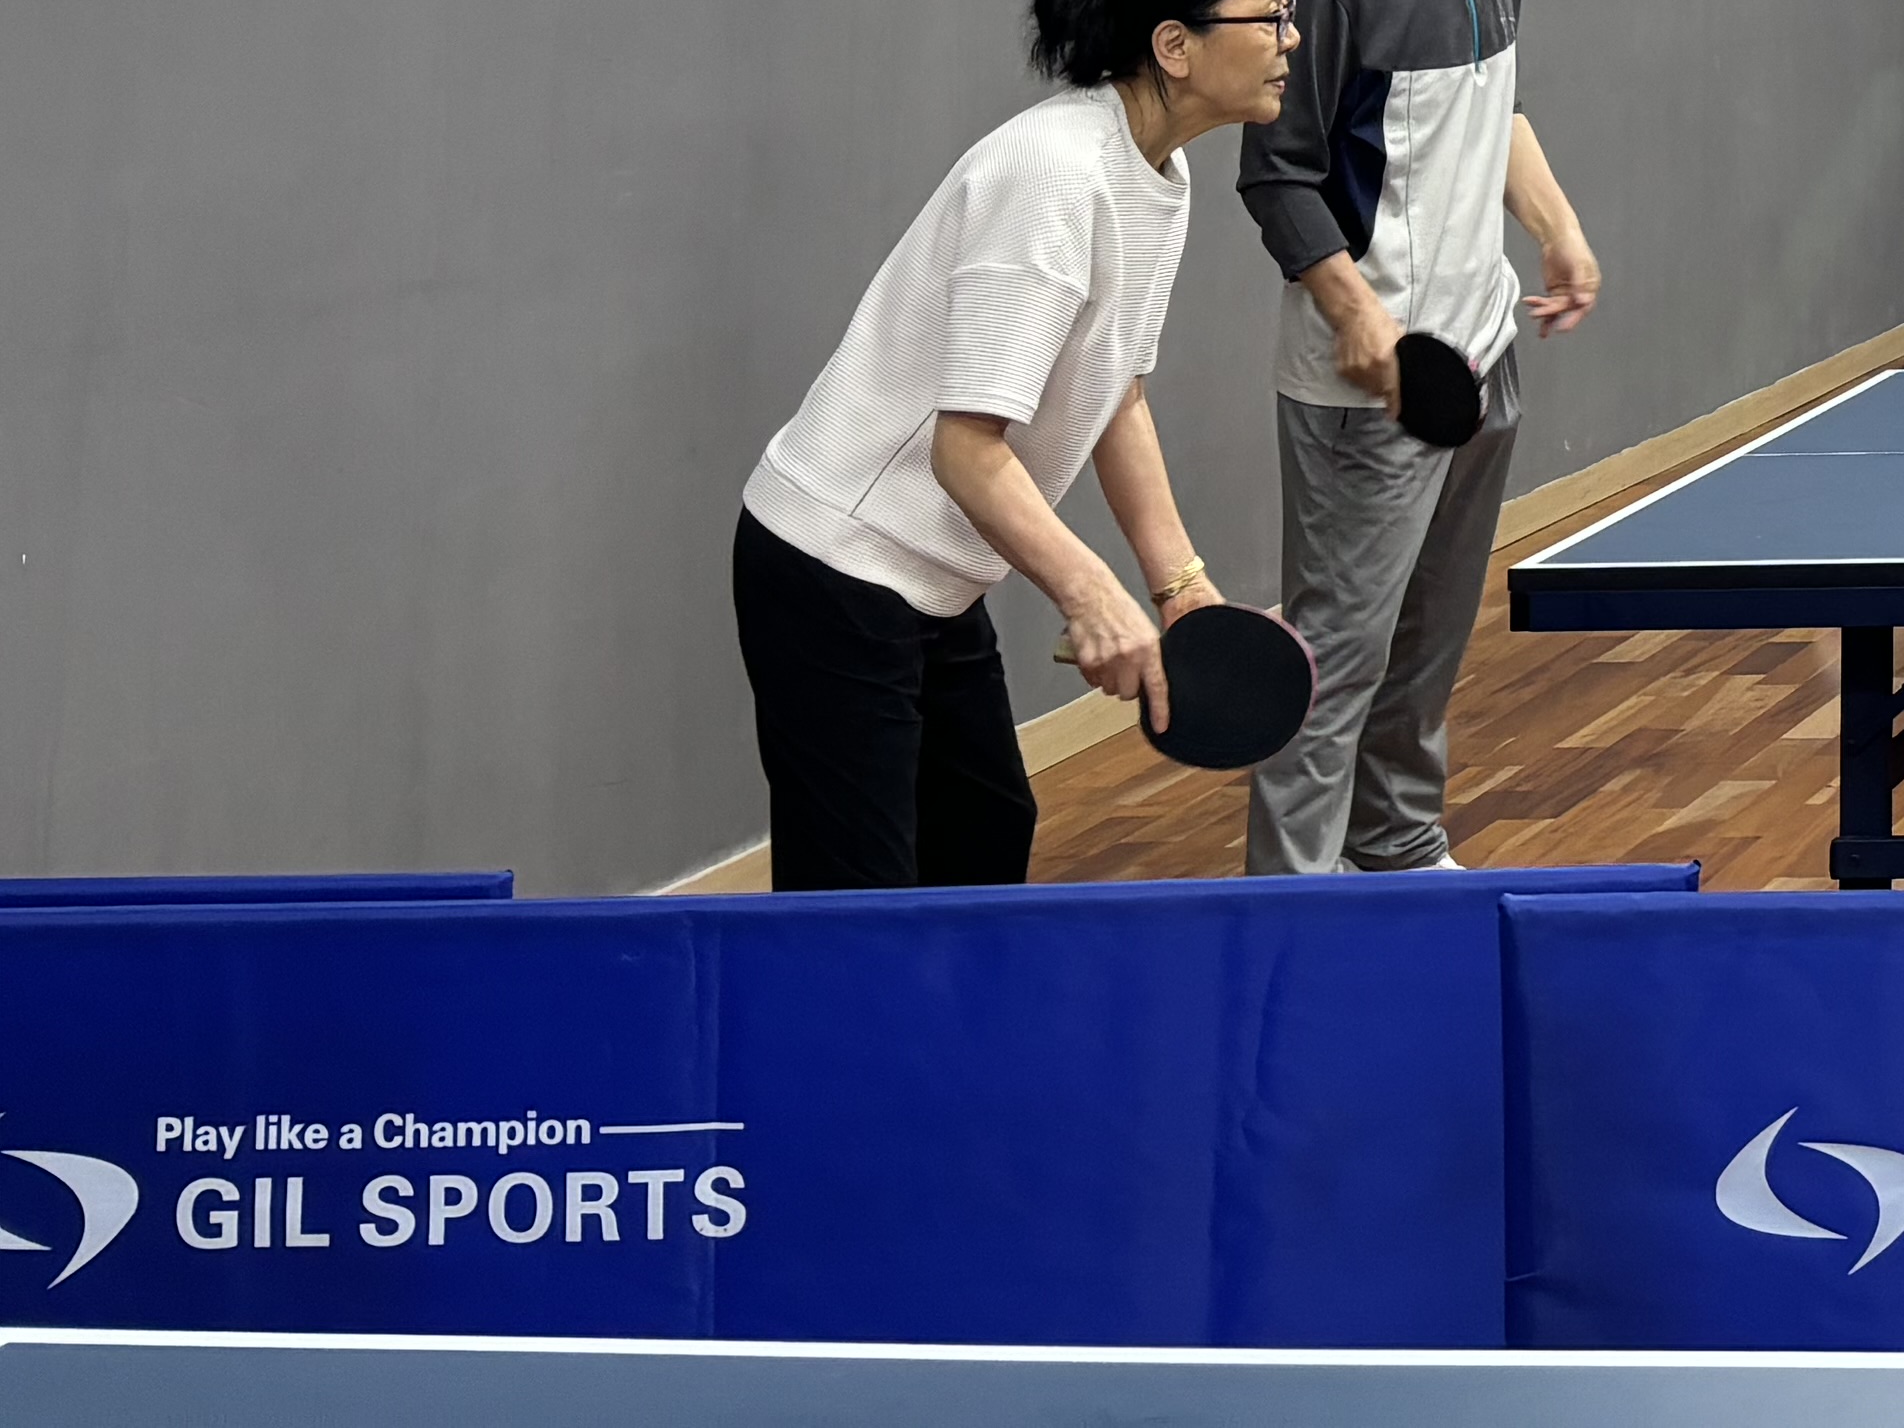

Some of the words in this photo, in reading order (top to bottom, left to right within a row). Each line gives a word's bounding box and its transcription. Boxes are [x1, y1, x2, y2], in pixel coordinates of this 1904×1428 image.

[156, 1116, 245, 1160] Play
[255, 1114, 329, 1150] like
[338, 1123, 363, 1150] a
[373, 1113, 591, 1155] Champion
[176, 1176, 330, 1250] GIL
[359, 1165, 747, 1247] SPORTS
